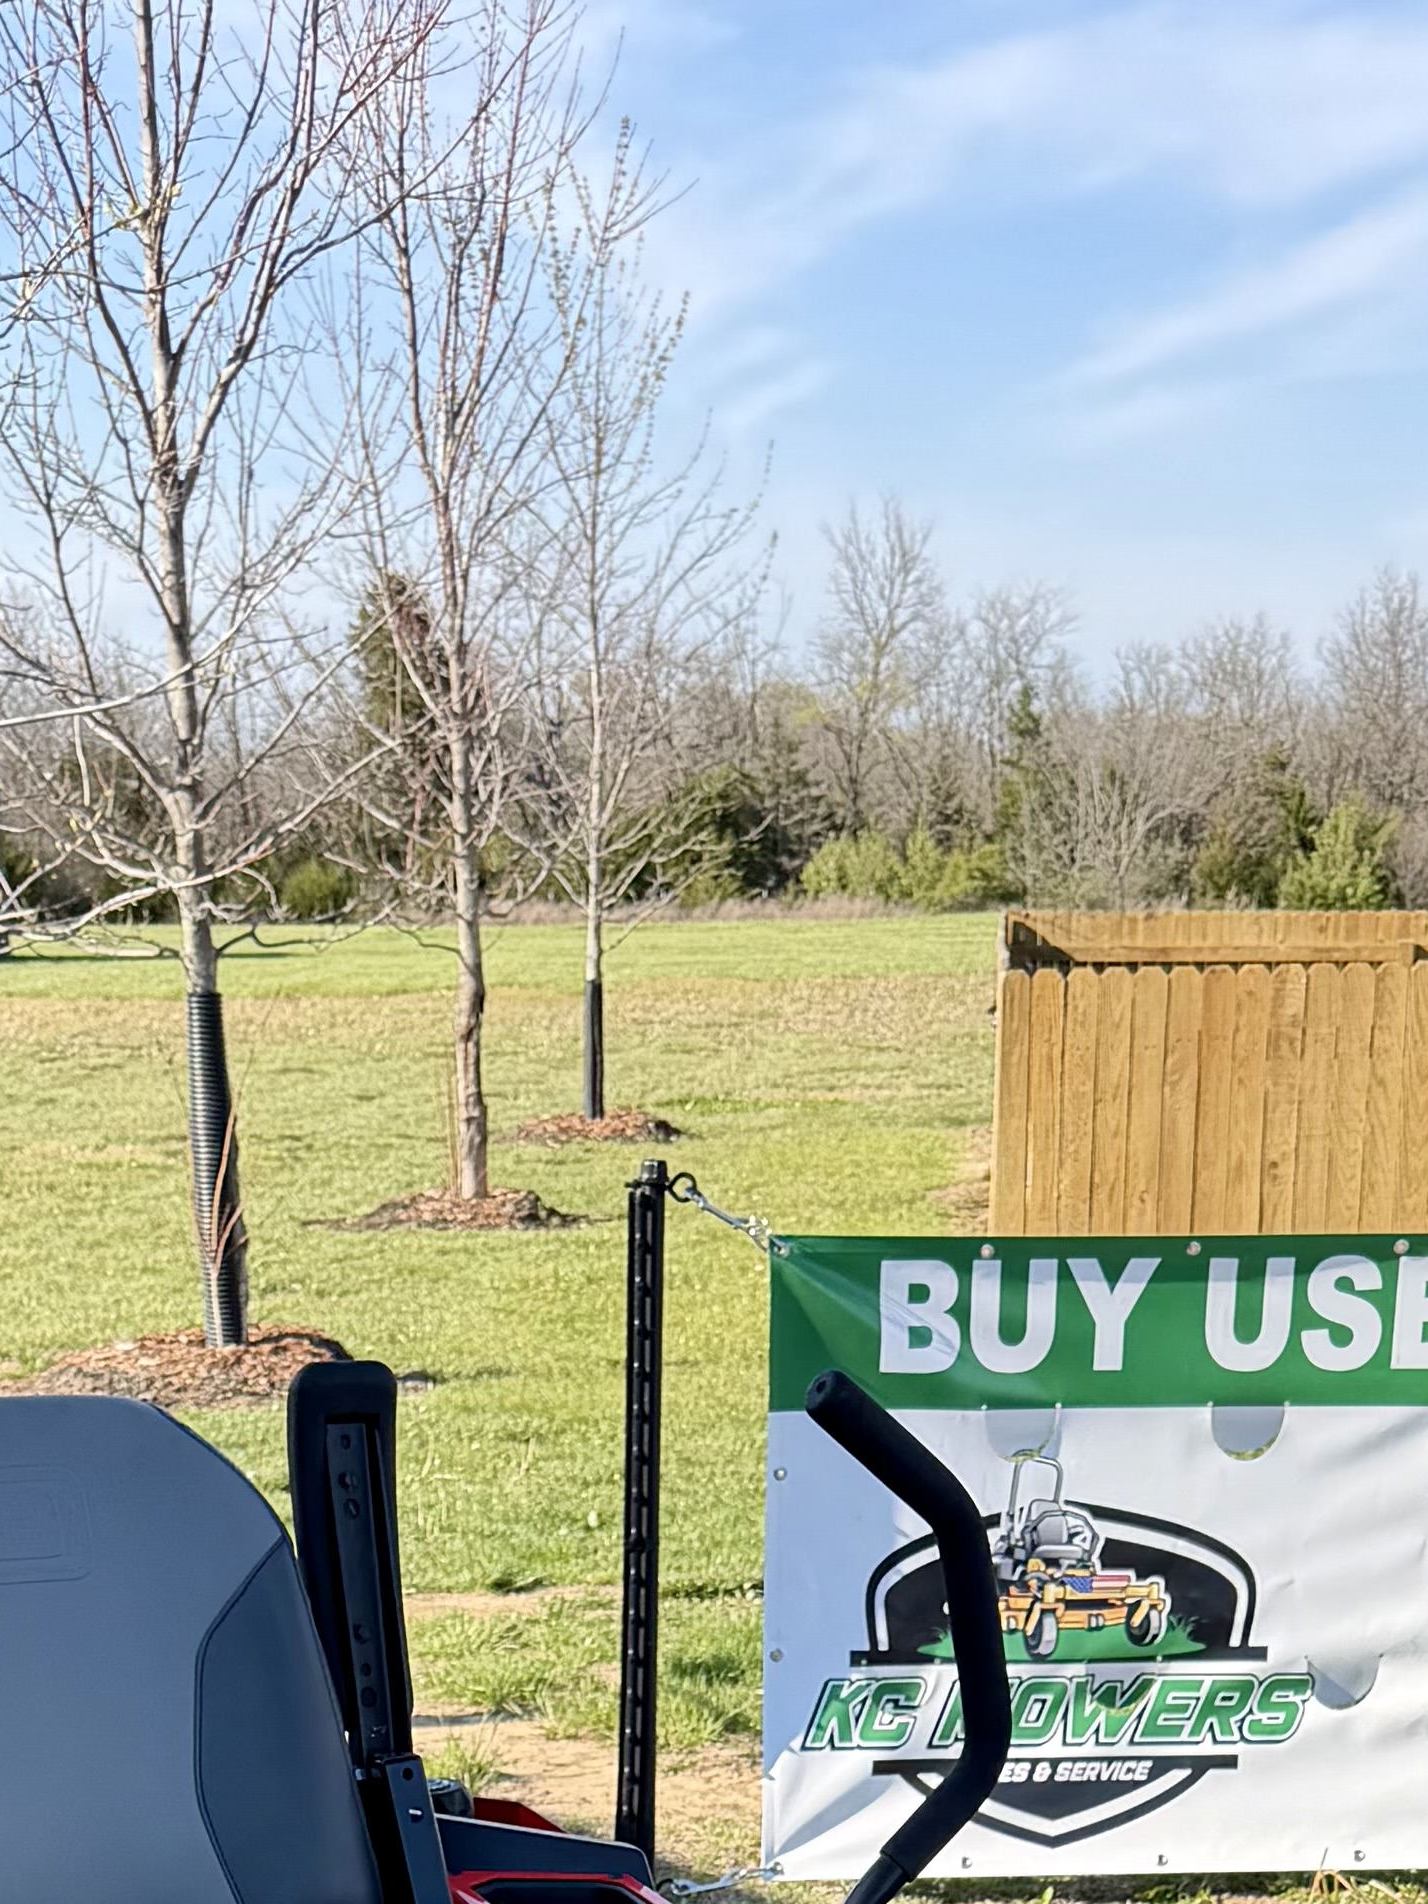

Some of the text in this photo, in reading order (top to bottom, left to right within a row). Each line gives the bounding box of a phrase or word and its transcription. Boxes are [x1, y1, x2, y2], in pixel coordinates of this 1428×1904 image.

[878, 1256, 1162, 1375] BUY
[801, 1676, 927, 1753] KC
[1032, 1761, 1053, 1783] &
[1054, 1760, 1154, 1783] SERVICE
